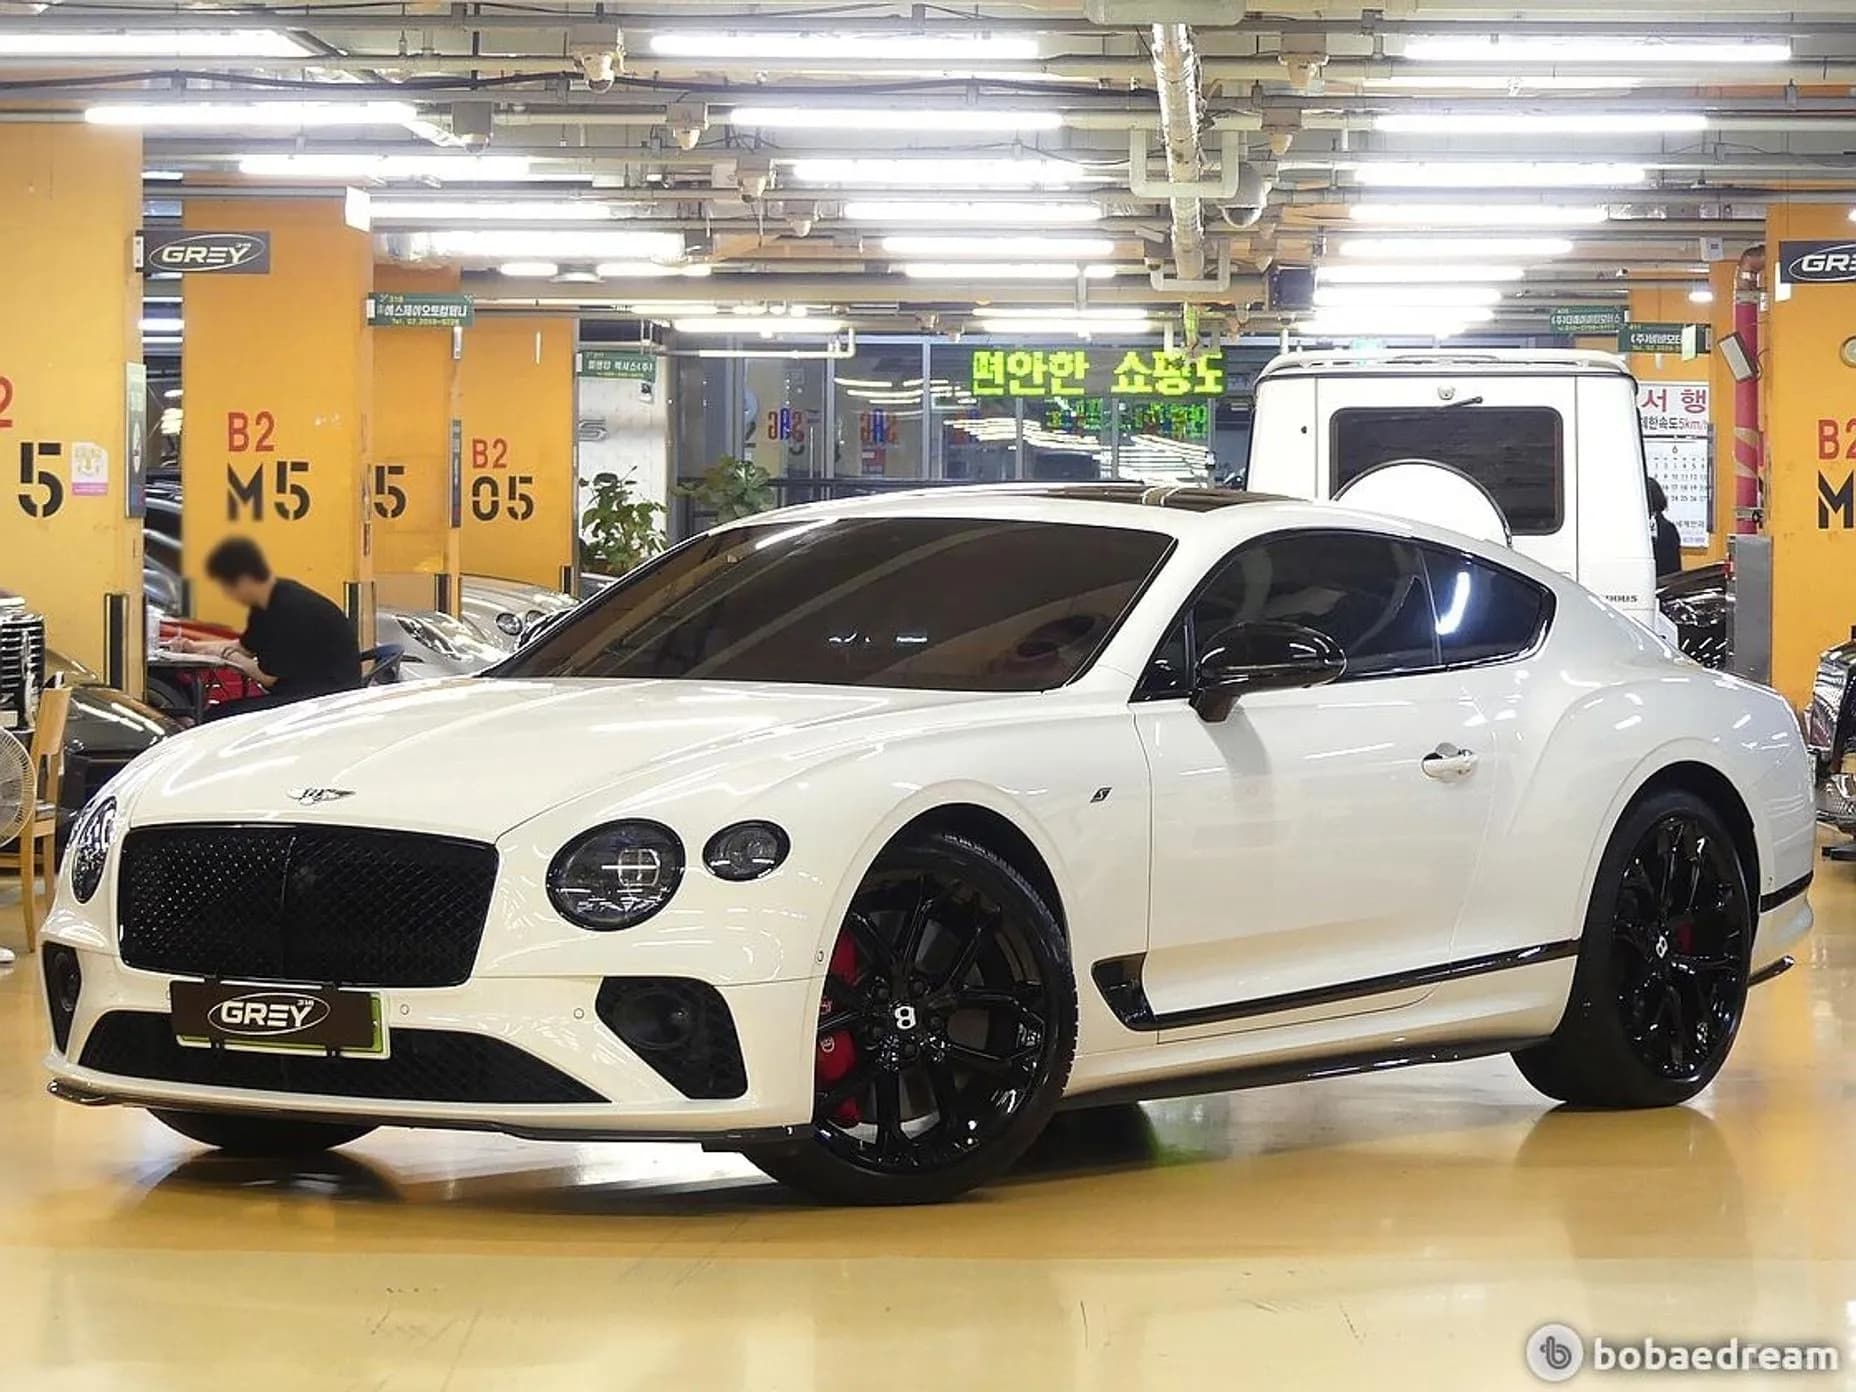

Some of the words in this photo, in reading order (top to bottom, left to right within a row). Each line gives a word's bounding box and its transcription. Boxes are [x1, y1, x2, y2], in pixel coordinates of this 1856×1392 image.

[162, 246, 249, 265] GREY
[1801, 254, 1856, 272] GR
[228, 411, 275, 452] B2
[472, 437, 507, 469] B2
[227, 460, 311, 521] M5
[220, 1000, 313, 1028] GREY
